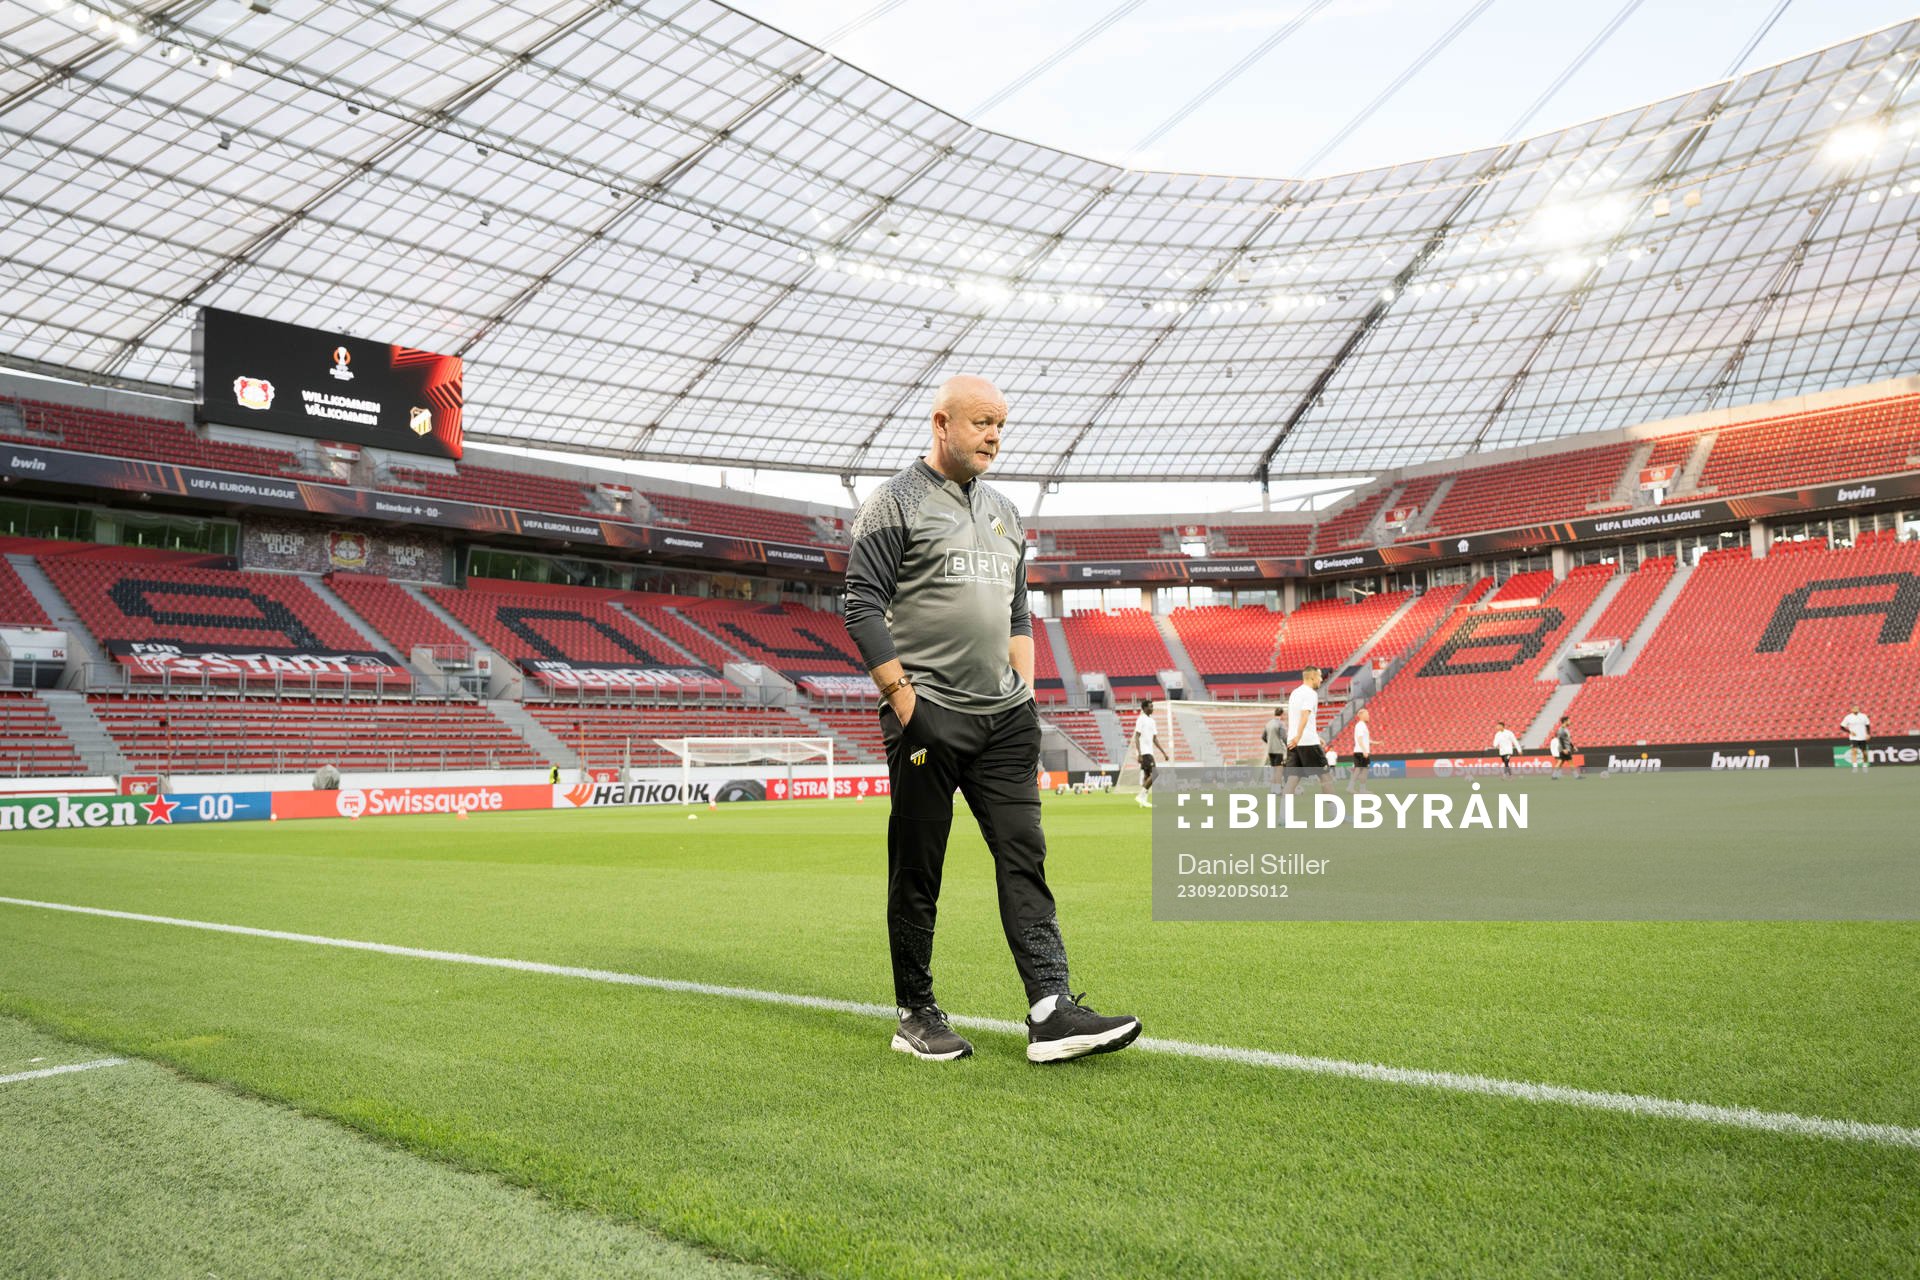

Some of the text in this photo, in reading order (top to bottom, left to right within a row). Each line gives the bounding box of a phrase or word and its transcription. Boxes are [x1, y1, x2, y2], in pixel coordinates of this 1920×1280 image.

[302, 390, 381, 413] WILLKOMMEN
[305, 404, 377, 426] VÄLKOMMEN
[11, 456, 46, 471] bwin
[191, 478, 296, 499] UEFA EUROPA LEAGUE
[1838, 486, 1876, 501] bwin
[523, 519, 599, 536] UEFA EUROPA LEAGUE
[1595, 510, 1701, 532] UEFA EUROPA LEAGUE
[268, 543, 297, 555] EUCH
[767, 550, 825, 563] UEFA EUROPA LEAGUE
[1207, 565, 1231, 573] EUROPA
[1232, 564, 1256, 573] LEAGUE
[201, 653, 351, 674] STADT
[1454, 758, 1553, 776] Swissuote
[1608, 753, 1661, 772] bwin
[1711, 749, 1769, 769] bwin
[1084, 771, 1112, 787] bwin
[199, 794, 234, 820] 0.0
[369, 788, 503, 814] Swissquote
